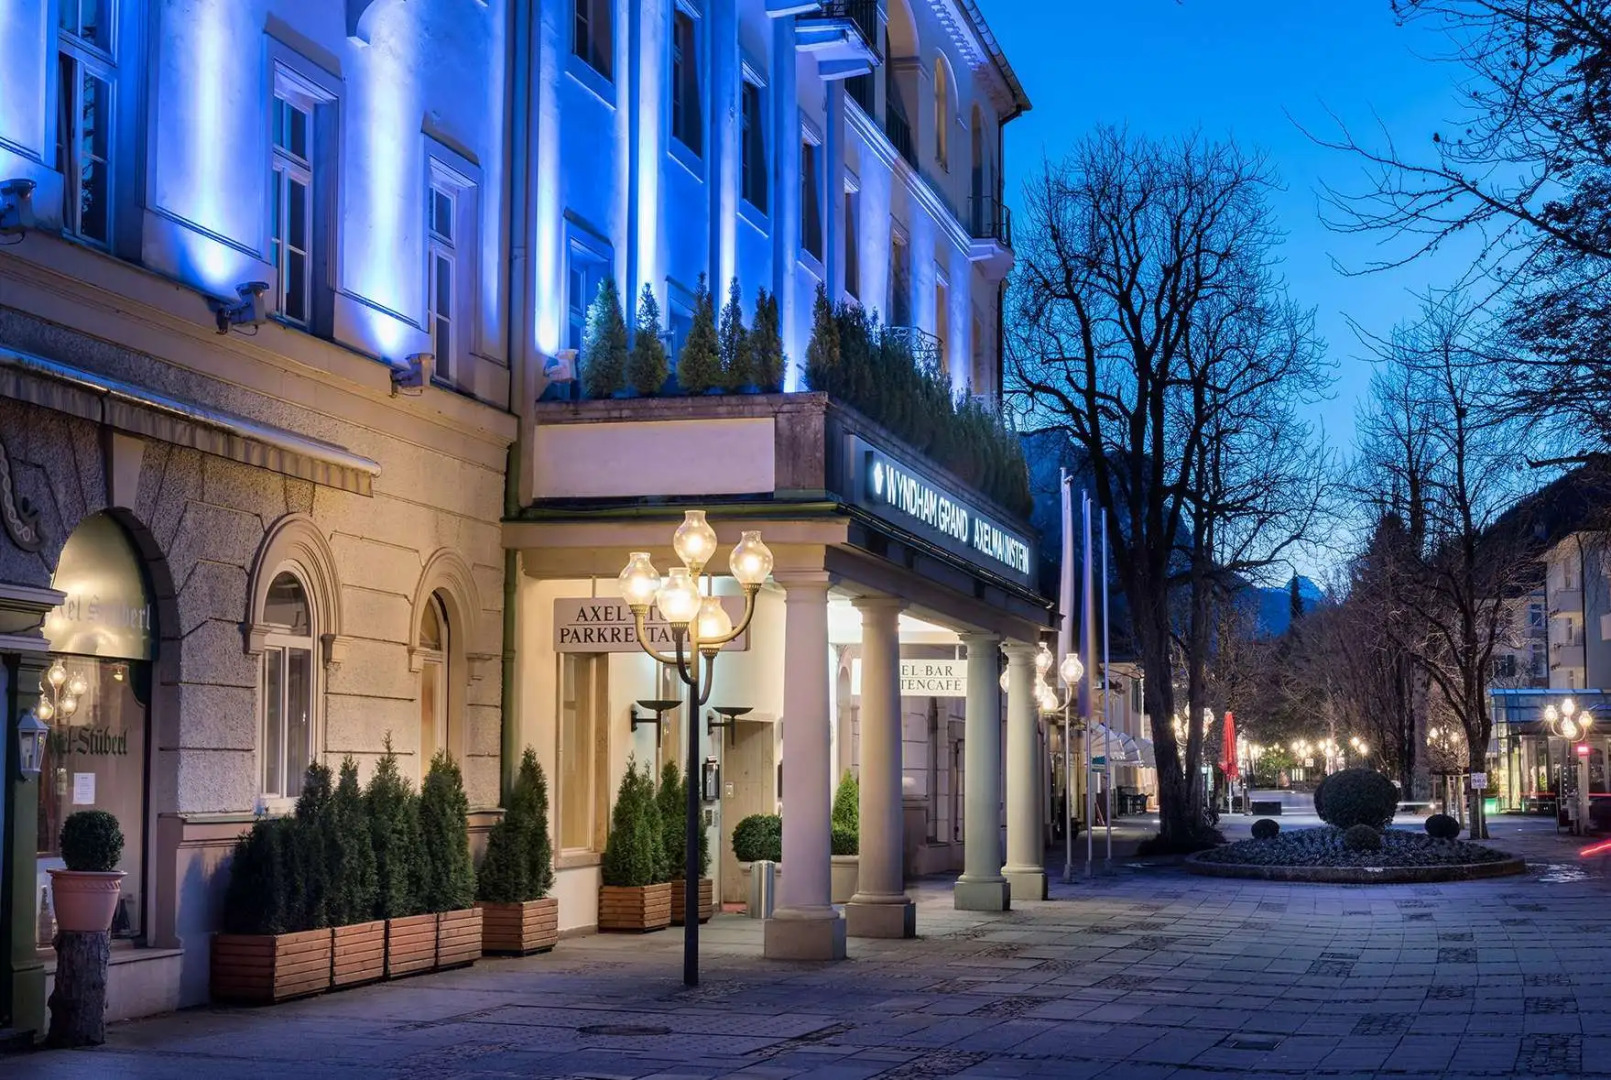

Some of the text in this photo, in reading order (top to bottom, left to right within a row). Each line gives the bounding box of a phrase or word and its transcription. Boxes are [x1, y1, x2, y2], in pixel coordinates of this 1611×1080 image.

[886, 464, 937, 527] WYNDHAM
[938, 496, 968, 542] GRAND
[901, 664, 953, 677] EL-BAR
